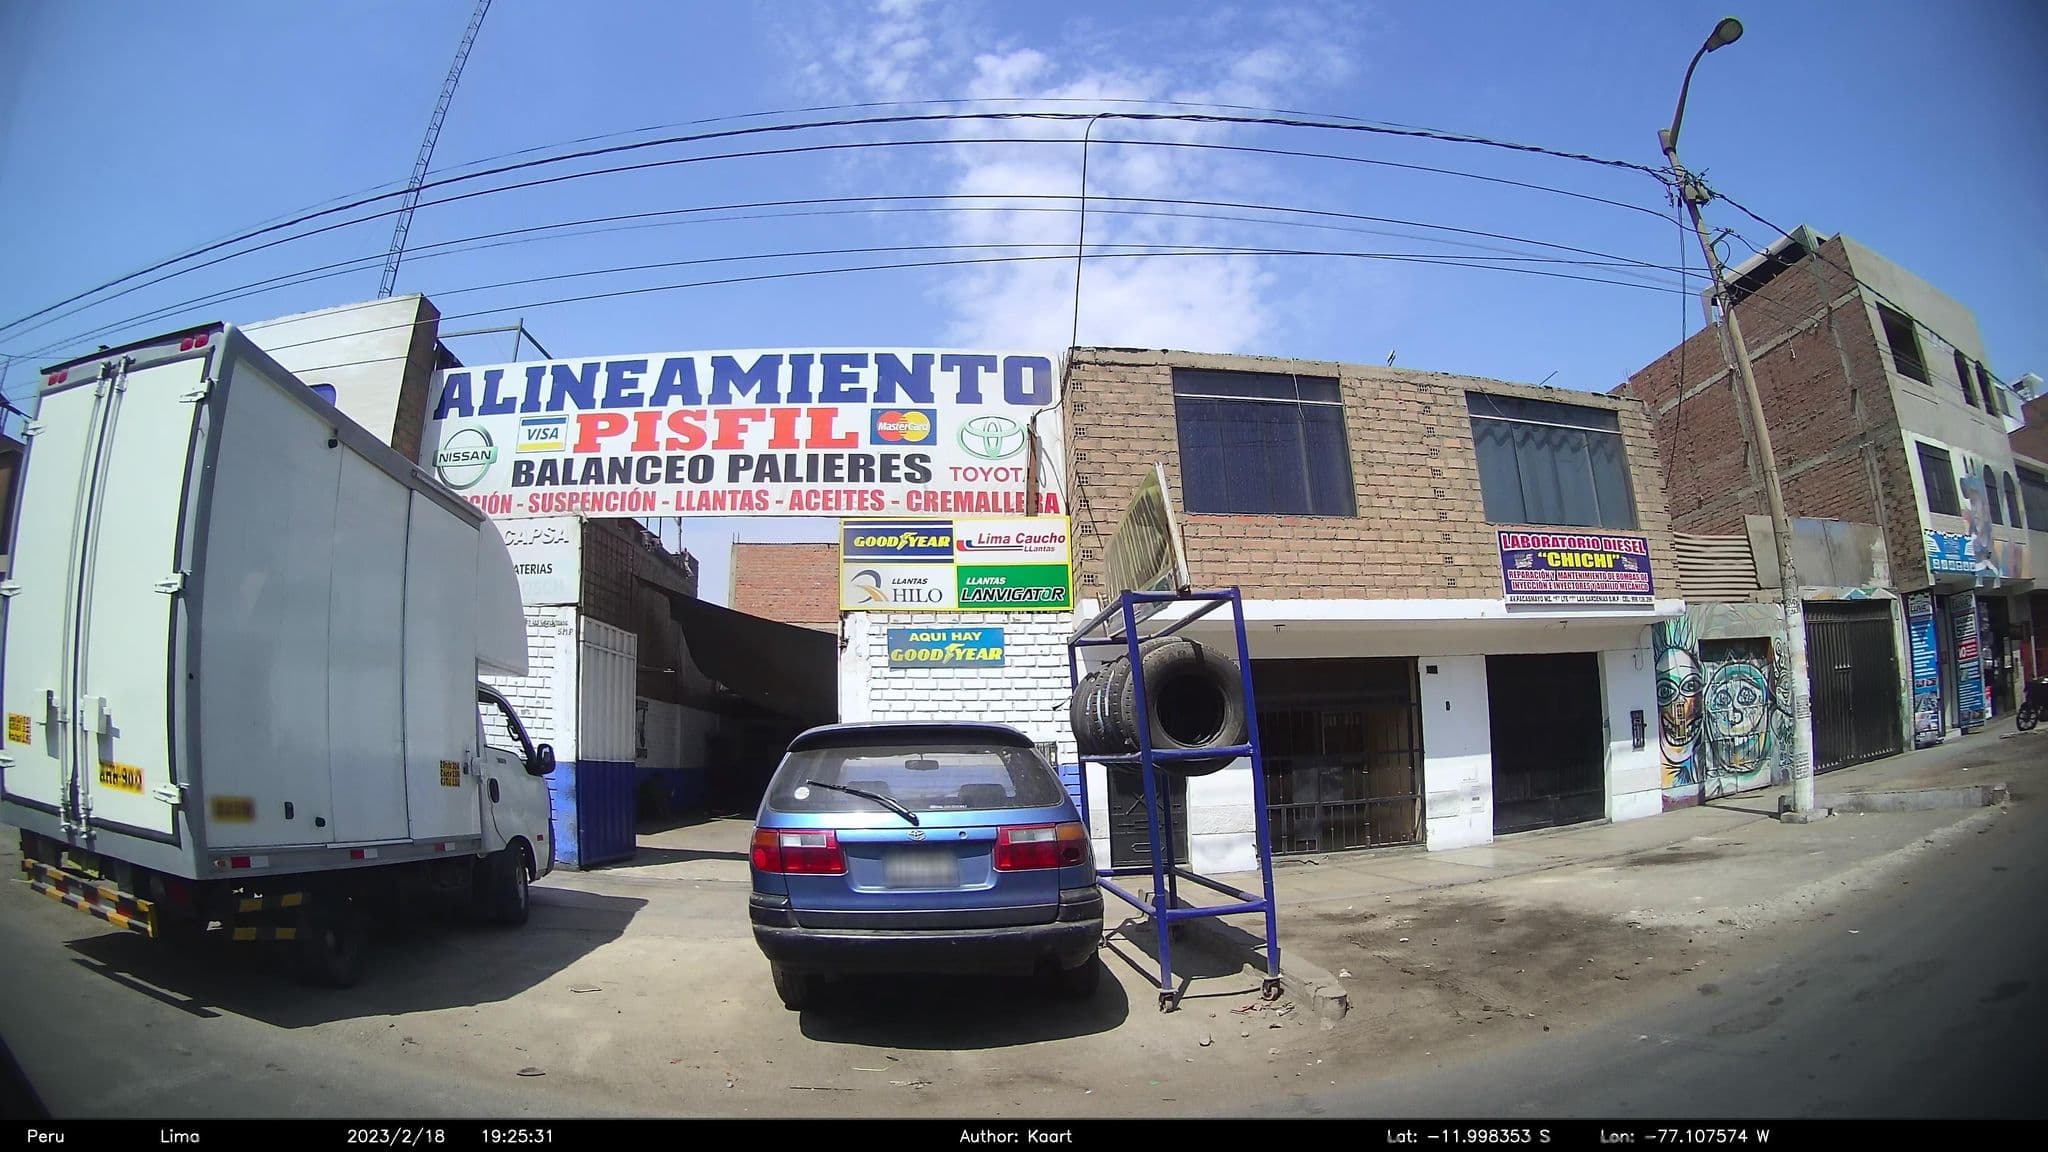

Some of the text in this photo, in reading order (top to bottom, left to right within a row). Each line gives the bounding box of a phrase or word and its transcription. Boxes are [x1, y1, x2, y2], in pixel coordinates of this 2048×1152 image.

[433, 353, 1052, 420] ALINEAMIENTO
[573, 408, 859, 453] PISFIL
[878, 421, 929, 431] MasterCard
[527, 427, 559, 441] VISA
[438, 450, 492, 463] NISSAN
[511, 453, 932, 488] BALANCEO PALIERES
[949, 466, 1025, 482] TOYOT
[462, 491, 513, 515] CIÓN
[529, 488, 656, 514] SUSPENCIÓN
[675, 489, 769, 512] LLANTAS
[789, 490, 885, 512] ACEITES
[854, 533, 950, 549] GOODYEAR
[978, 532, 1066, 544] Lima Caucho
[1501, 533, 1647, 555] LABORATORIO DIESEL
[513, 563, 552, 575] ATERIAS
[966, 577, 1006, 585] LLANTAS
[892, 588, 943, 603] HILO
[961, 587, 1065, 602] LANVIGATOR
[909, 632, 982, 642] AQUI HAY
[891, 643, 1002, 662] GOODYEAR
